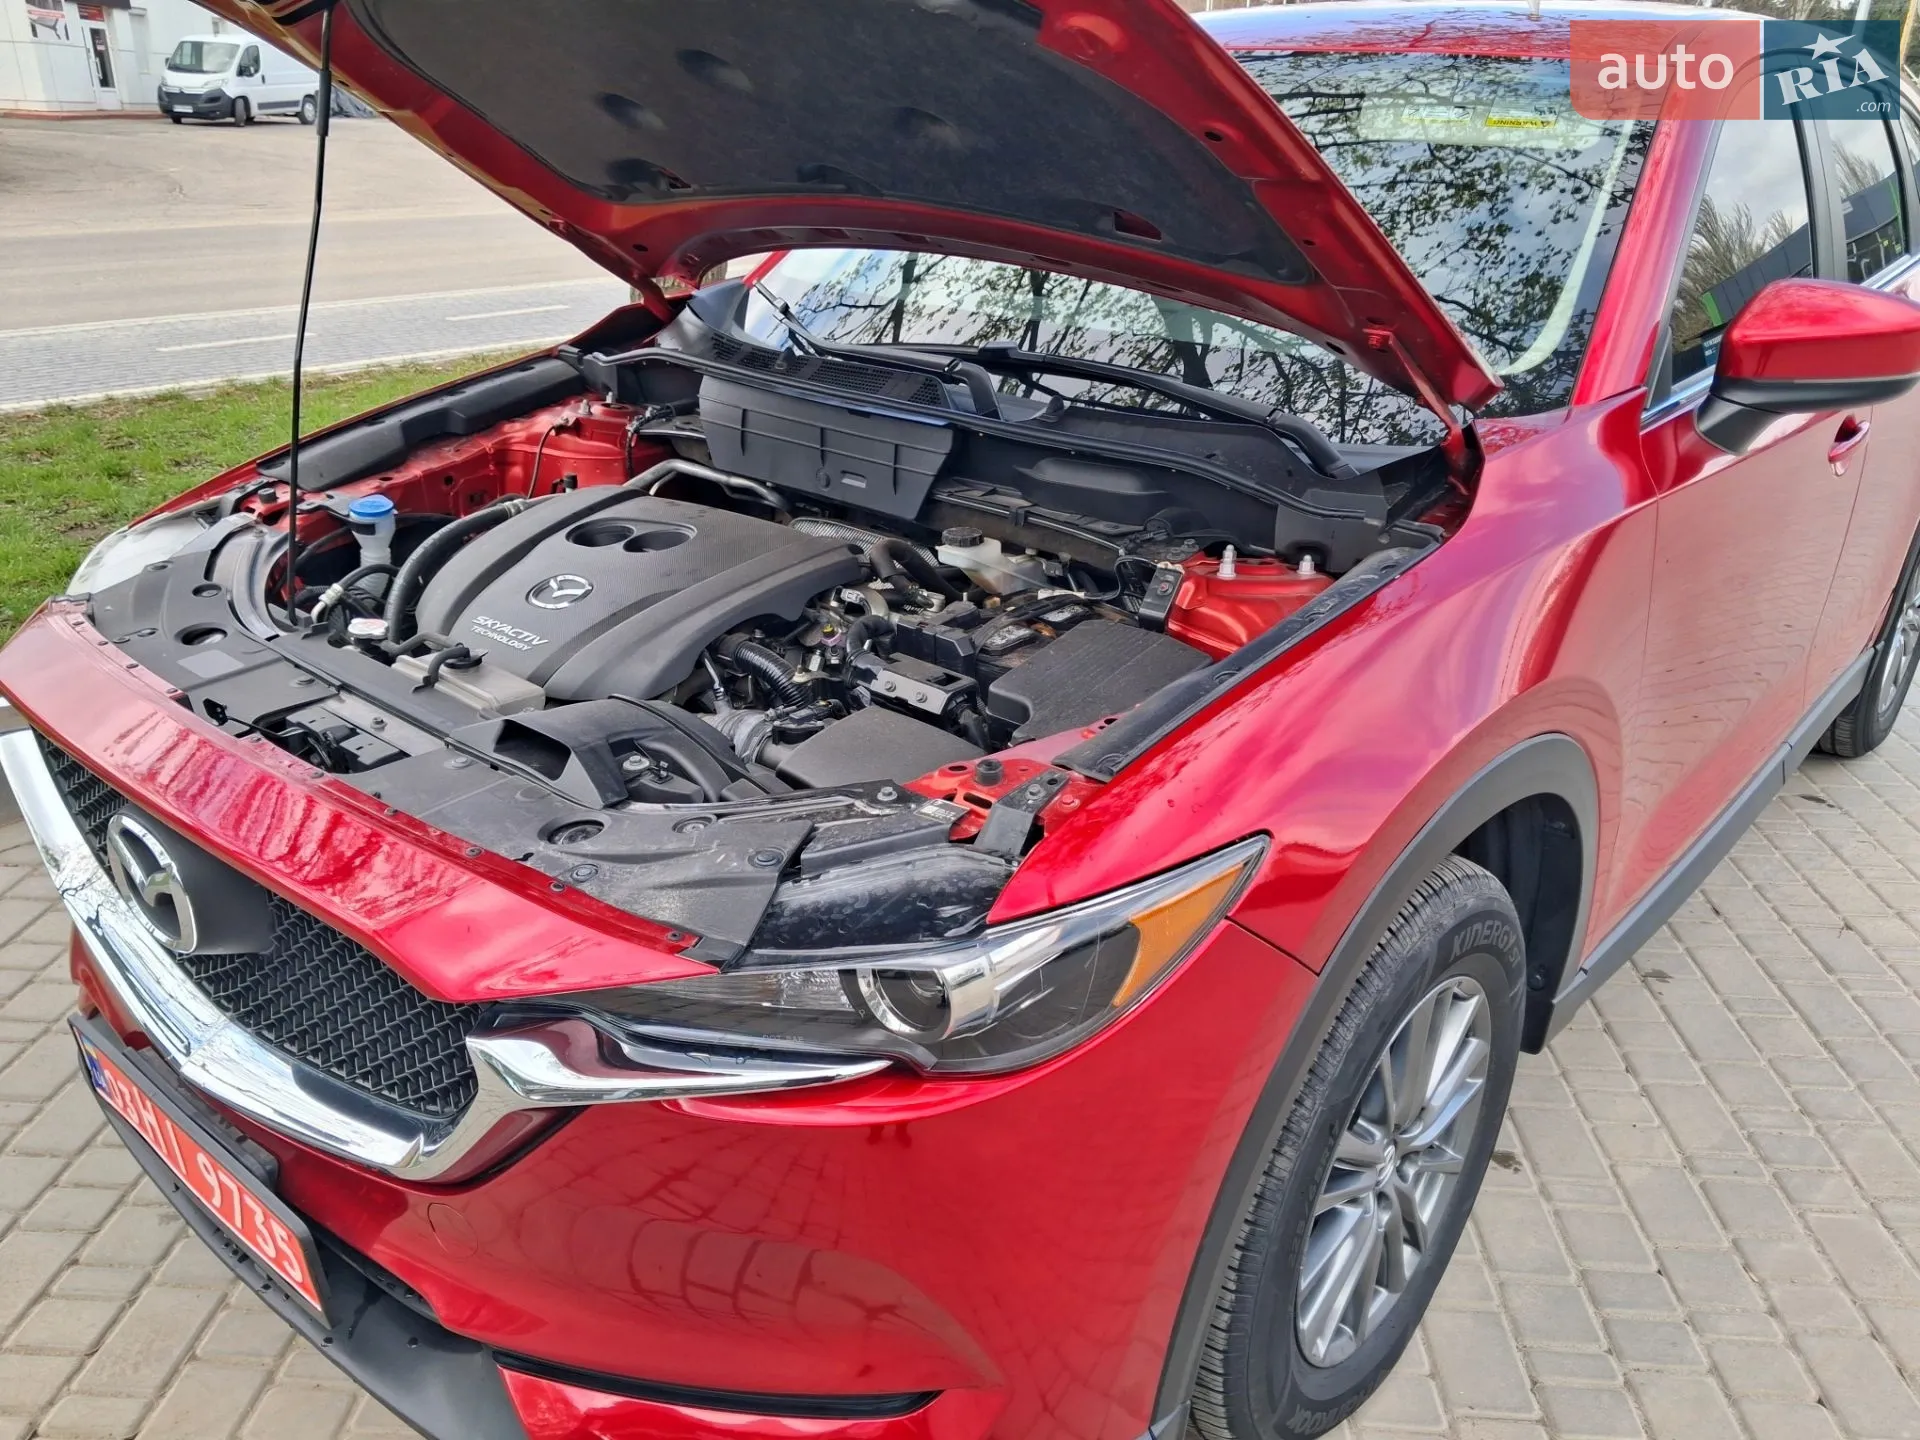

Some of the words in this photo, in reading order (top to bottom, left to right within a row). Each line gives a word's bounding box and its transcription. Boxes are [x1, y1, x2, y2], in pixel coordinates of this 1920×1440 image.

[471, 615, 549, 646] SKYACTIV
[471, 625, 532, 651] TECHNOLOGY
[1448, 919, 1517, 963] KINERGY
[196, 1152, 304, 1283] 9735
